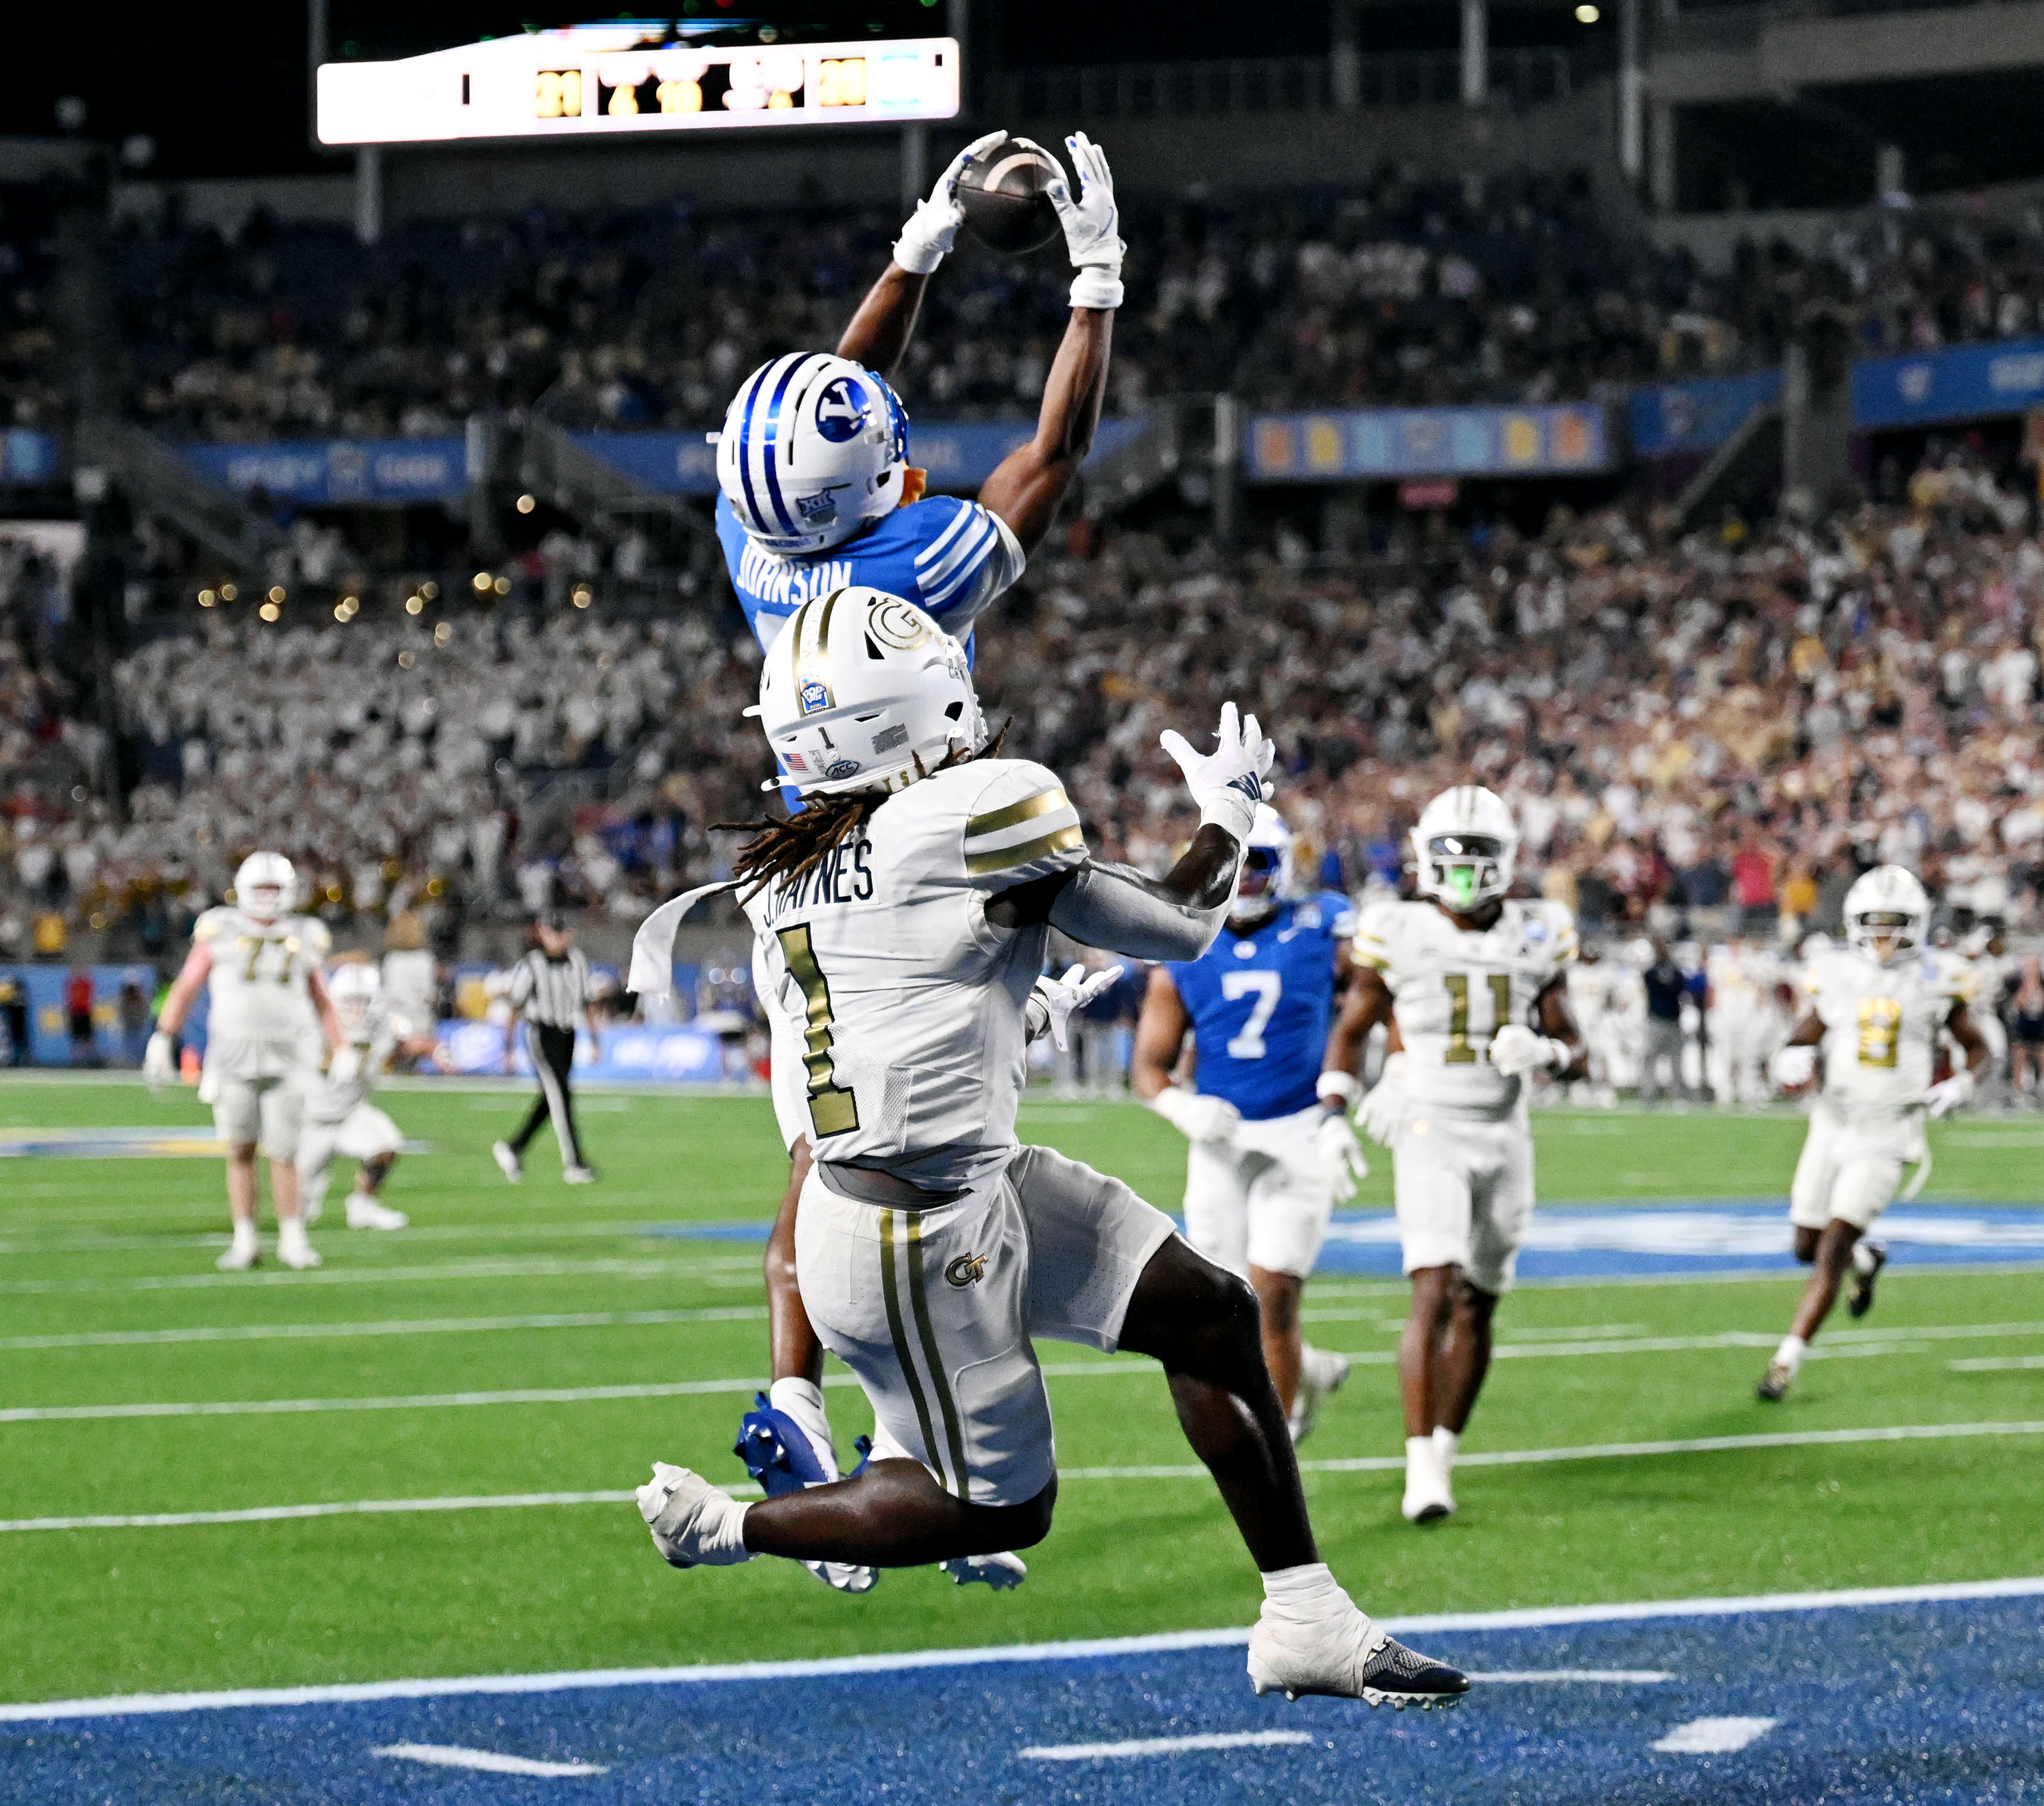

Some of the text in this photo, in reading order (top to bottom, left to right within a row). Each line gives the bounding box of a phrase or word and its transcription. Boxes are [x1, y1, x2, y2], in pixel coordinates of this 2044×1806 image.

[819, 381, 864, 430] Y
[737, 544, 852, 606] JOHNSON
[818, 726, 835, 750] 1
[831, 761, 854, 776] ACC
[236, 936, 300, 983] 77
[775, 922, 860, 1139] 1
[1220, 969, 1282, 1059] 7
[1444, 974, 1510, 1062] 11
